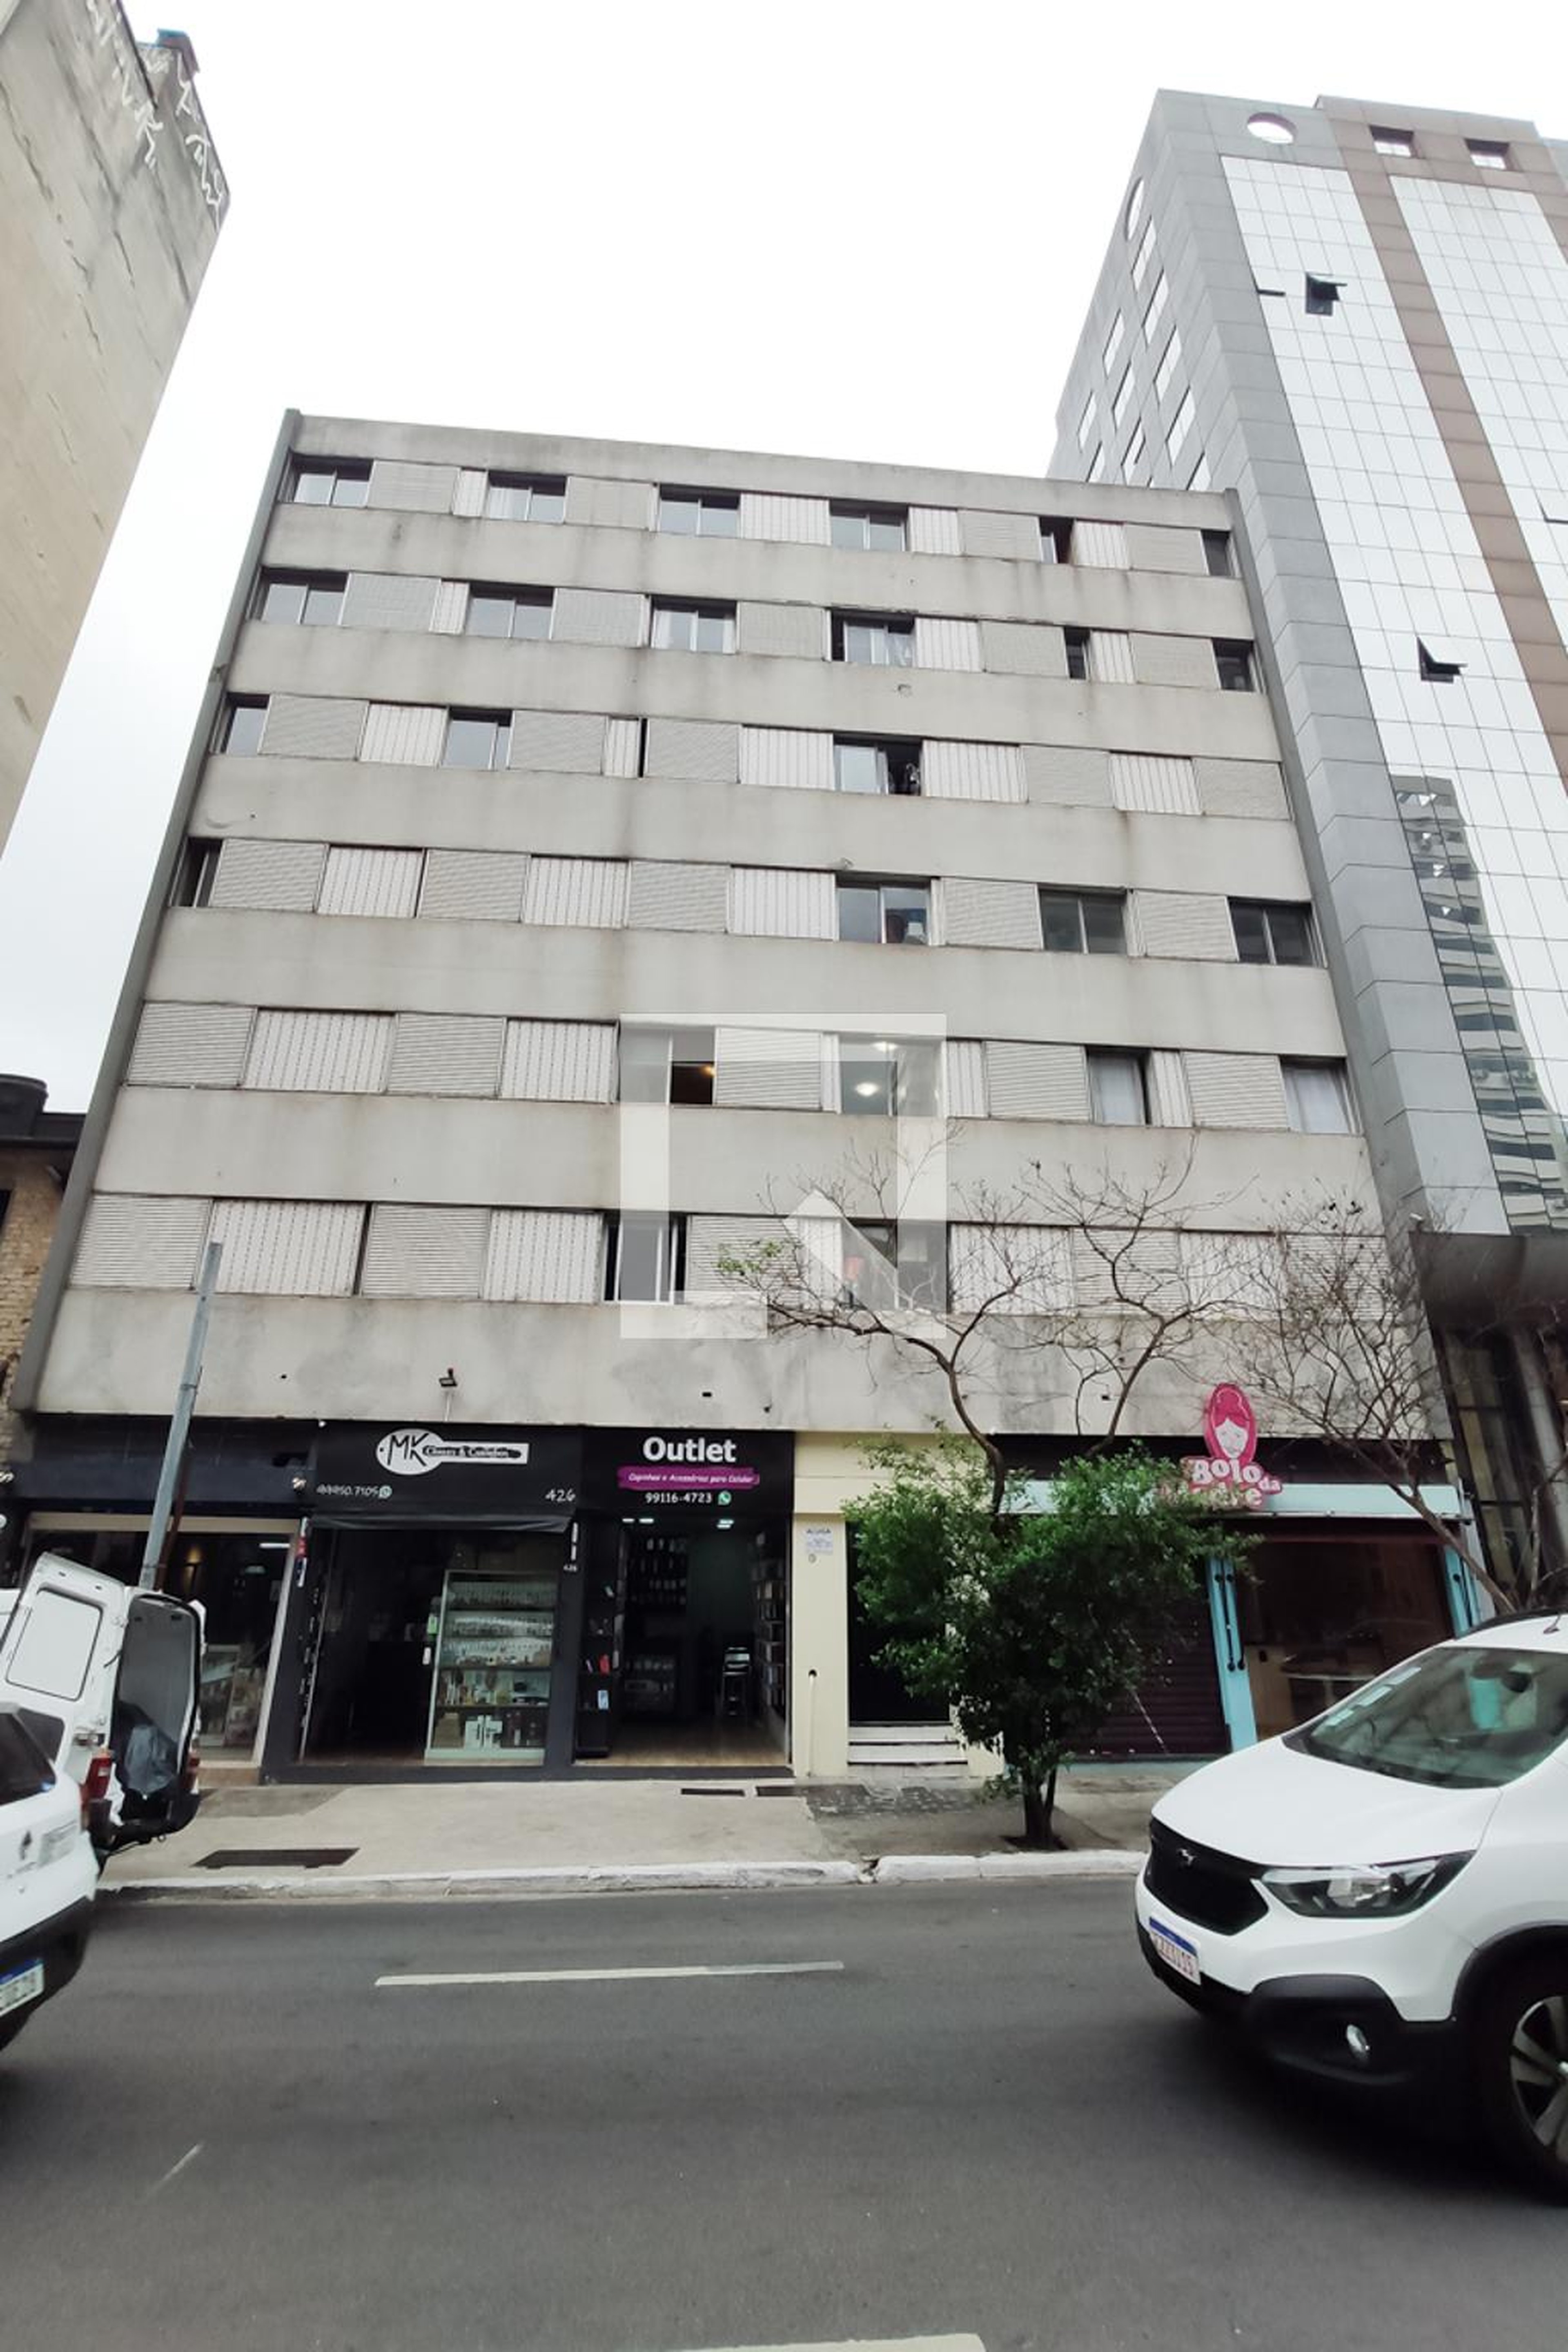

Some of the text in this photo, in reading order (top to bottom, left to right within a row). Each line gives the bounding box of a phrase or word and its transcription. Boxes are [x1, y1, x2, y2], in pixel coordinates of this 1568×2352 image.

[388, 1432, 429, 1467] MK
[643, 1437, 737, 1463] Outlet
[1191, 1459, 1281, 1491] Bolo da
[546, 1490, 576, 1501] 426
[645, 1492, 712, 1503] 99116-4723
